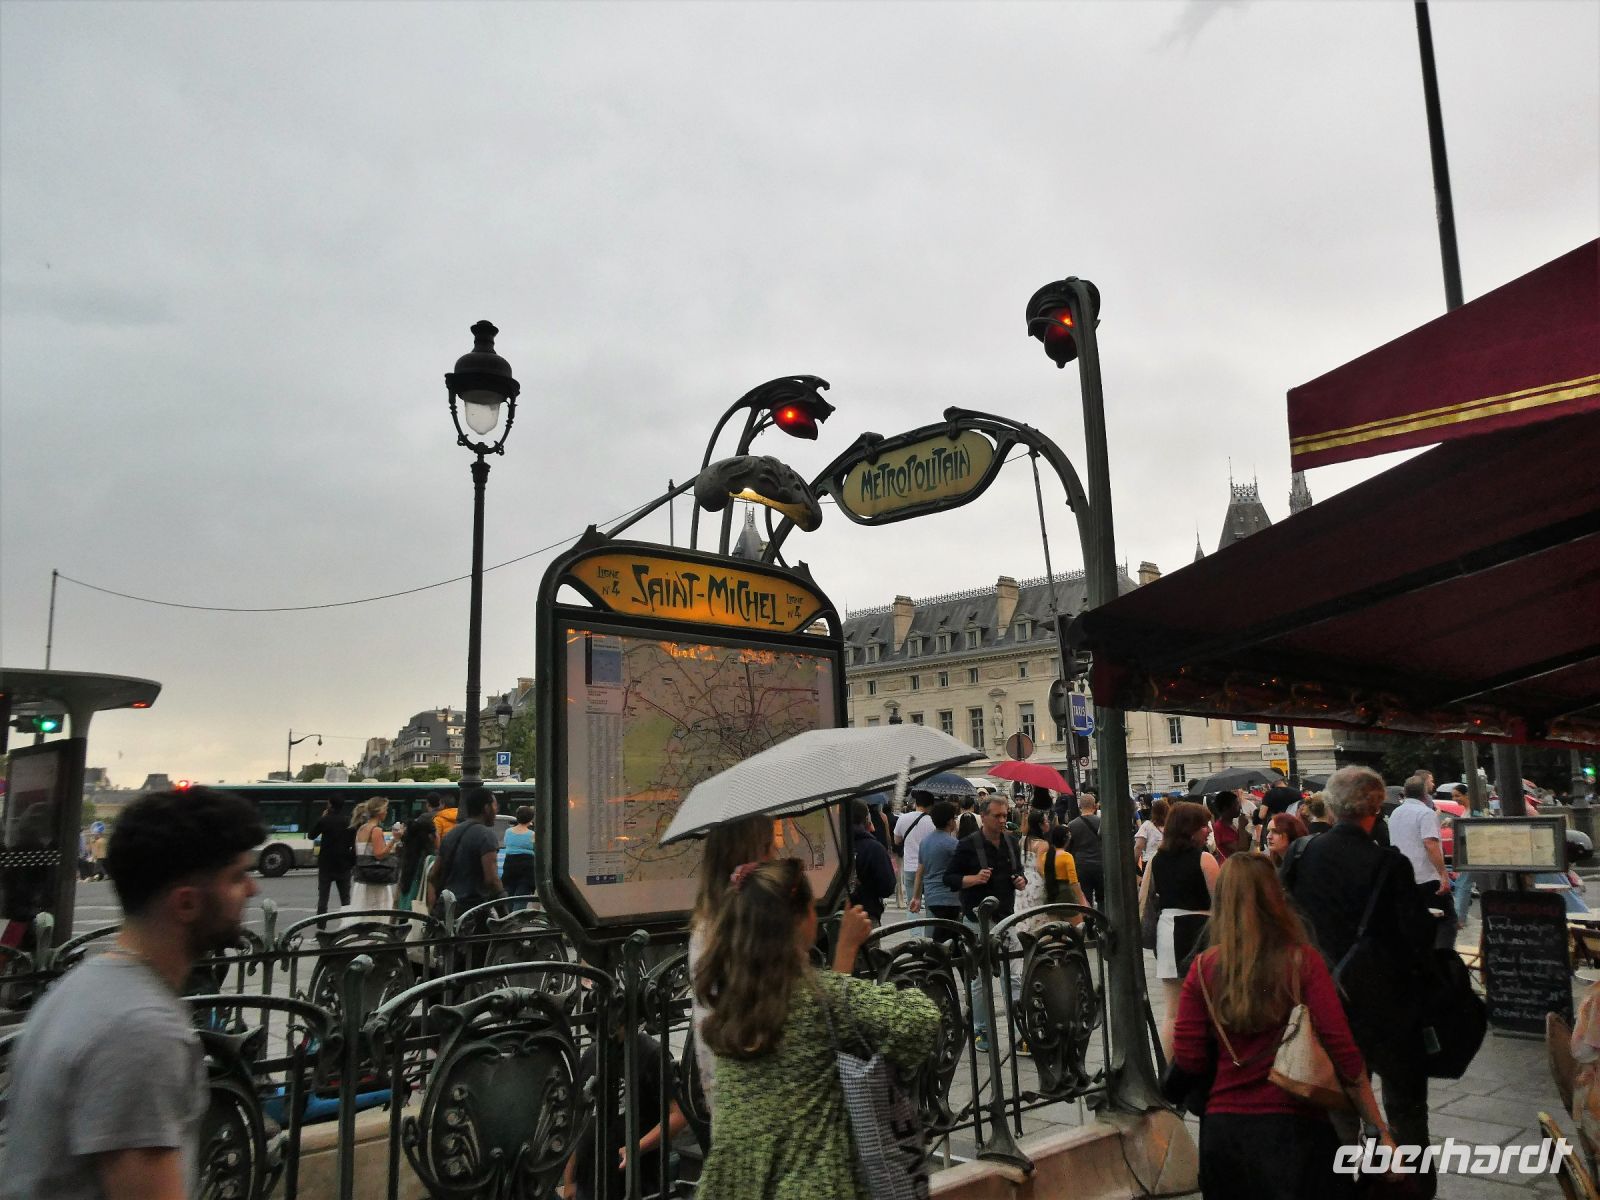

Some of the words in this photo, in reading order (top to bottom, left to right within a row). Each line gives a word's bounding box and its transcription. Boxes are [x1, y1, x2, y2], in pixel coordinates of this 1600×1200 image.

[860, 444, 971, 502] METROPOLITAIN
[631, 564, 785, 626] SAINT-MICHEL
[500, 754, 507, 764] P
